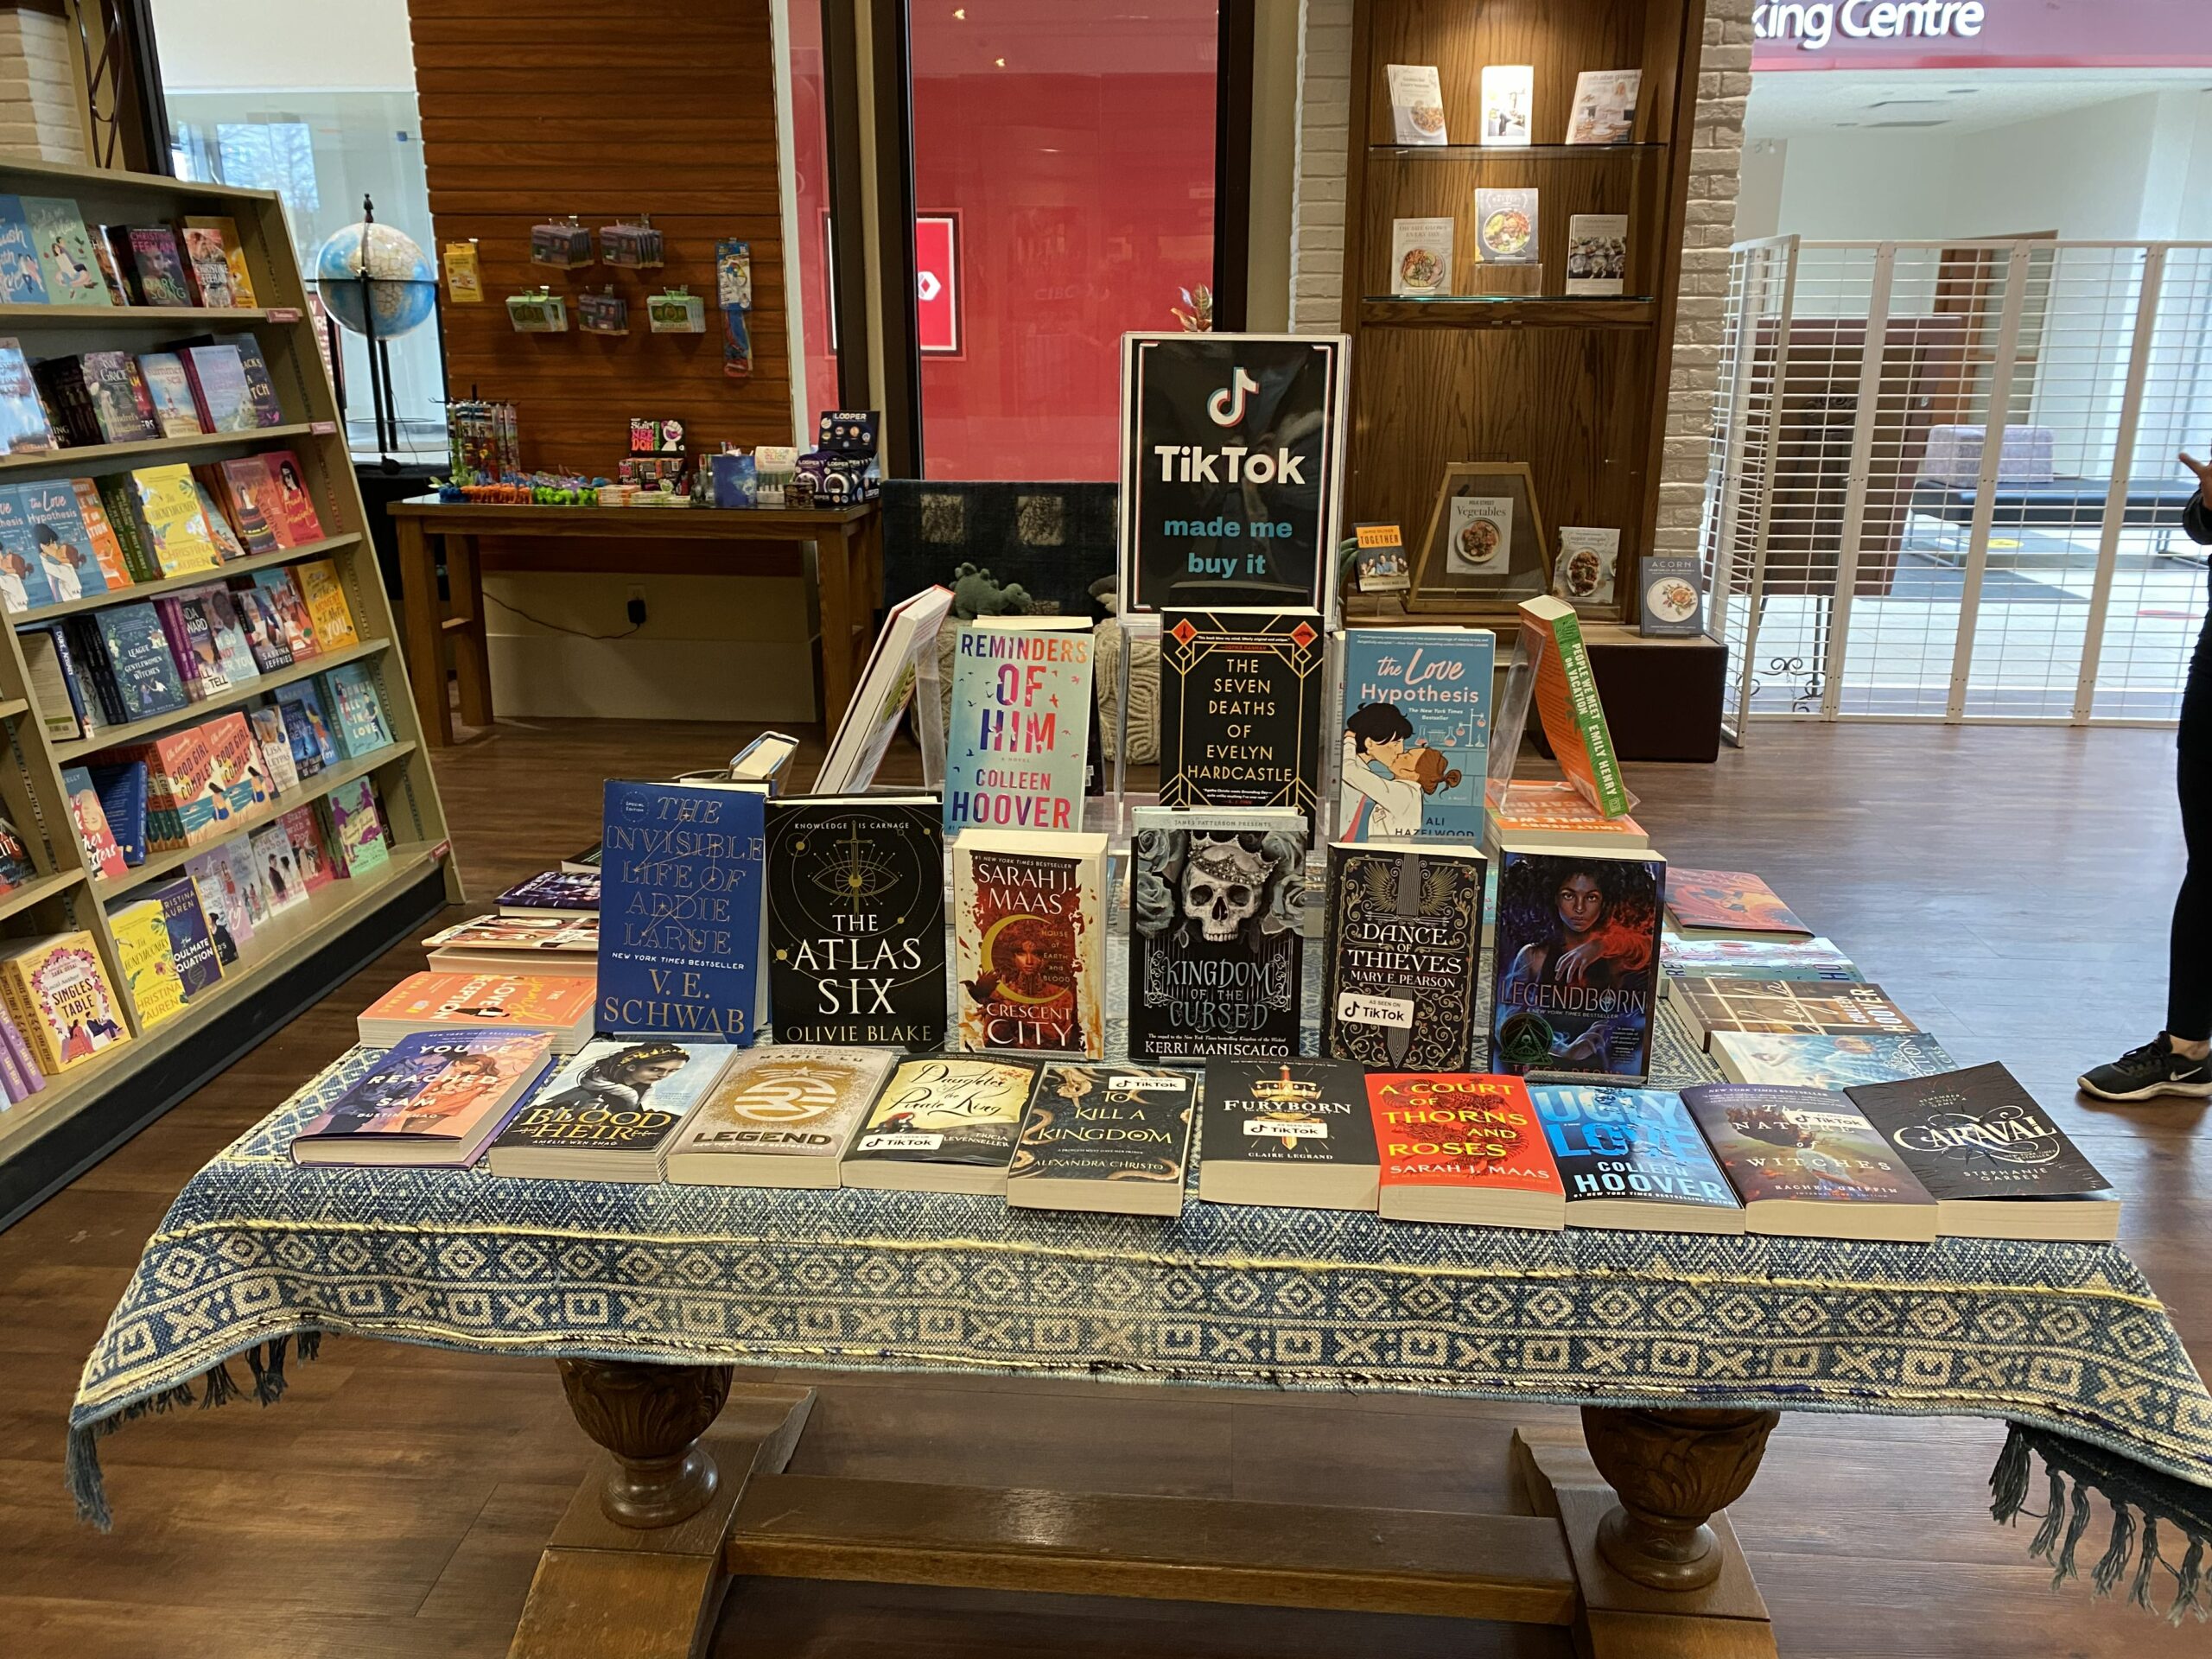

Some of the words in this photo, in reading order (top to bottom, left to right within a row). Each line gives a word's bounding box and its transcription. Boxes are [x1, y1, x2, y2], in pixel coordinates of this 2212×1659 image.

[1840, 0, 1986, 37] Centre
[143, 277, 177, 291] DARK
[151, 287, 187, 300] SONG
[100, 368, 128, 382] GRACE
[1154, 446, 1306, 484] TikTok
[29, 498, 42, 510] the
[43, 490, 67, 512] Love
[27, 509, 77, 524] Hypothesis
[1457, 505, 1506, 518] Vegetables
[1164, 517, 1241, 537] made
[1250, 519, 1293, 537] me
[1360, 535, 1399, 545] TOGETHER
[1188, 553, 1237, 578] buy
[1247, 554, 1266, 574] it
[128, 644, 150, 658] LEAGUE
[262, 647, 289, 661] SABRINA
[961, 633, 1088, 664] REMINDERS
[124, 656, 162, 673] GENTLEWOMEN
[265, 655, 293, 670] JEFFRIES
[1226, 658, 1259, 674] THE
[1377, 656, 1403, 677] the
[1404, 648, 1466, 685] Love
[1564, 657, 1573, 670] ON
[1572, 642, 1590, 678] PEOPLE
[134, 667, 161, 681] WITCHES
[996, 664, 1047, 707] OF
[1213, 679, 1272, 695] SEVEN
[1361, 683, 1479, 704] Hypothesis
[1568, 669, 1588, 715] VACATION
[1582, 677, 1592, 694] WE
[1209, 702, 1275, 716] DEATHS
[1586, 692, 1601, 720] MEET
[353, 722, 378, 740] LOVE
[980, 709, 1056, 753] HIM
[1227, 724, 1251, 739] OF
[1206, 745, 1273, 761] EVELYN
[1588, 724, 1607, 758] EMILY
[1599, 760, 1618, 797] HENRY
[172, 760, 194, 786] GOOD
[193, 741, 210, 764] GIRL
[181, 758, 215, 801] COMPLEX
[976, 769, 1052, 791] COLLEEN
[1187, 765, 1293, 782] HARDCASTLE
[657, 796, 723, 824] THE
[951, 791, 1071, 830] HOOVER
[1426, 817, 1445, 827] ALI
[607, 824, 765, 861] INVISIBLE
[621, 860, 693, 888] LIFE
[700, 867, 747, 892] OF
[978, 863, 1054, 890] SARAH
[1060, 870, 1073, 895] J.
[626, 891, 730, 922] ADDIE
[988, 887, 1062, 915] MAAS
[832, 914, 879, 931] THE
[623, 922, 731, 955] LARUE
[1041, 930, 1068, 938] HOUSE
[1362, 923, 1448, 946] DANCE
[792, 938, 921, 971] ATLAS
[1396, 944, 1412, 953] OF
[661, 957, 685, 965] TIMES
[688, 959, 745, 969] BESTSELLER
[1347, 949, 1462, 975] THIEVES
[649, 969, 672, 995] V.
[681, 971, 710, 1000] E.
[1043, 974, 1071, 982] BLOOD
[1160, 957, 1274, 995] KINGDOM
[1351, 969, 1384, 982] MARY
[1387, 973, 1397, 984] E.
[1399, 975, 1456, 988] PEARSON
[52, 977, 93, 1006] SINGLES
[818, 978, 896, 1015] SIX
[1191, 988, 1207, 1000] OF
[1217, 989, 1243, 1001] THE
[1500, 980, 1648, 1014] LEGENDBORN
[62, 999, 95, 1020] TABLE
[603, 996, 746, 1034] SCHWAB
[986, 1002, 1072, 1020] CRESCENT
[1169, 999, 1268, 1031] CURSED
[1363, 1007, 1404, 1021] TikTok
[1833, 995, 1870, 1024] COLLEEN
[1850, 988, 1911, 1033] HOOVER
[786, 1026, 858, 1044] OLIVIE
[867, 1025, 931, 1043] BLAKE
[987, 1019, 1074, 1046] CITY
[419, 1045, 512, 1054] YOU'VE
[1145, 1041, 1188, 1054] KERRI
[1192, 1042, 1289, 1057] MANISCALCO
[367, 1074, 499, 1085] REACHED
[911, 1063, 1005, 1094] Daughter
[1101, 1090, 1130, 1103] TO
[1378, 1084, 1400, 1095] A
[1411, 1084, 1514, 1095] COURT
[376, 1097, 437, 1108] SAM
[1224, 1099, 1351, 1115] FURYBORN
[1409, 1097, 1440, 1106] OF
[1535, 1089, 1681, 1128] UGLY
[520, 1107, 671, 1128] BLOOD
[1075, 1108, 1123, 1121] KILL
[1129, 1109, 1146, 1121] A
[1381, 1110, 1529, 1125] THORNS
[1815, 1116, 1863, 1126] TikTok
[531, 1123, 636, 1141] HEIR
[1037, 1127, 1173, 1144] KINGDOM
[1466, 1128, 1517, 1139] AND
[1732, 1121, 1855, 1134] NATURE
[1893, 1115, 2057, 1153] CARAVAL
[692, 1131, 832, 1146] LEGEND
[944, 1136, 1010, 1147] LEVENSELLER
[1547, 1123, 1713, 1165] LOVE
[1796, 1140, 1819, 1150] of
[1388, 1142, 1507, 1157] ROSES
[1035, 1159, 1105, 1167] ALEXANDRA
[1109, 1160, 1164, 1170] CHRISTO
[1390, 1165, 1461, 1174] SARAH
[1469, 1165, 1481, 1174] J.
[1489, 1166, 1550, 1179] MAAS
[1598, 1161, 1688, 1177] COLLEEN
[1745, 1156, 1892, 1171] WITCHES
[1963, 1167, 2049, 1178] STEPHANIE
[1573, 1173, 1727, 1199] HOOVER
[1837, 1185, 1898, 1193] GRIFFIN
